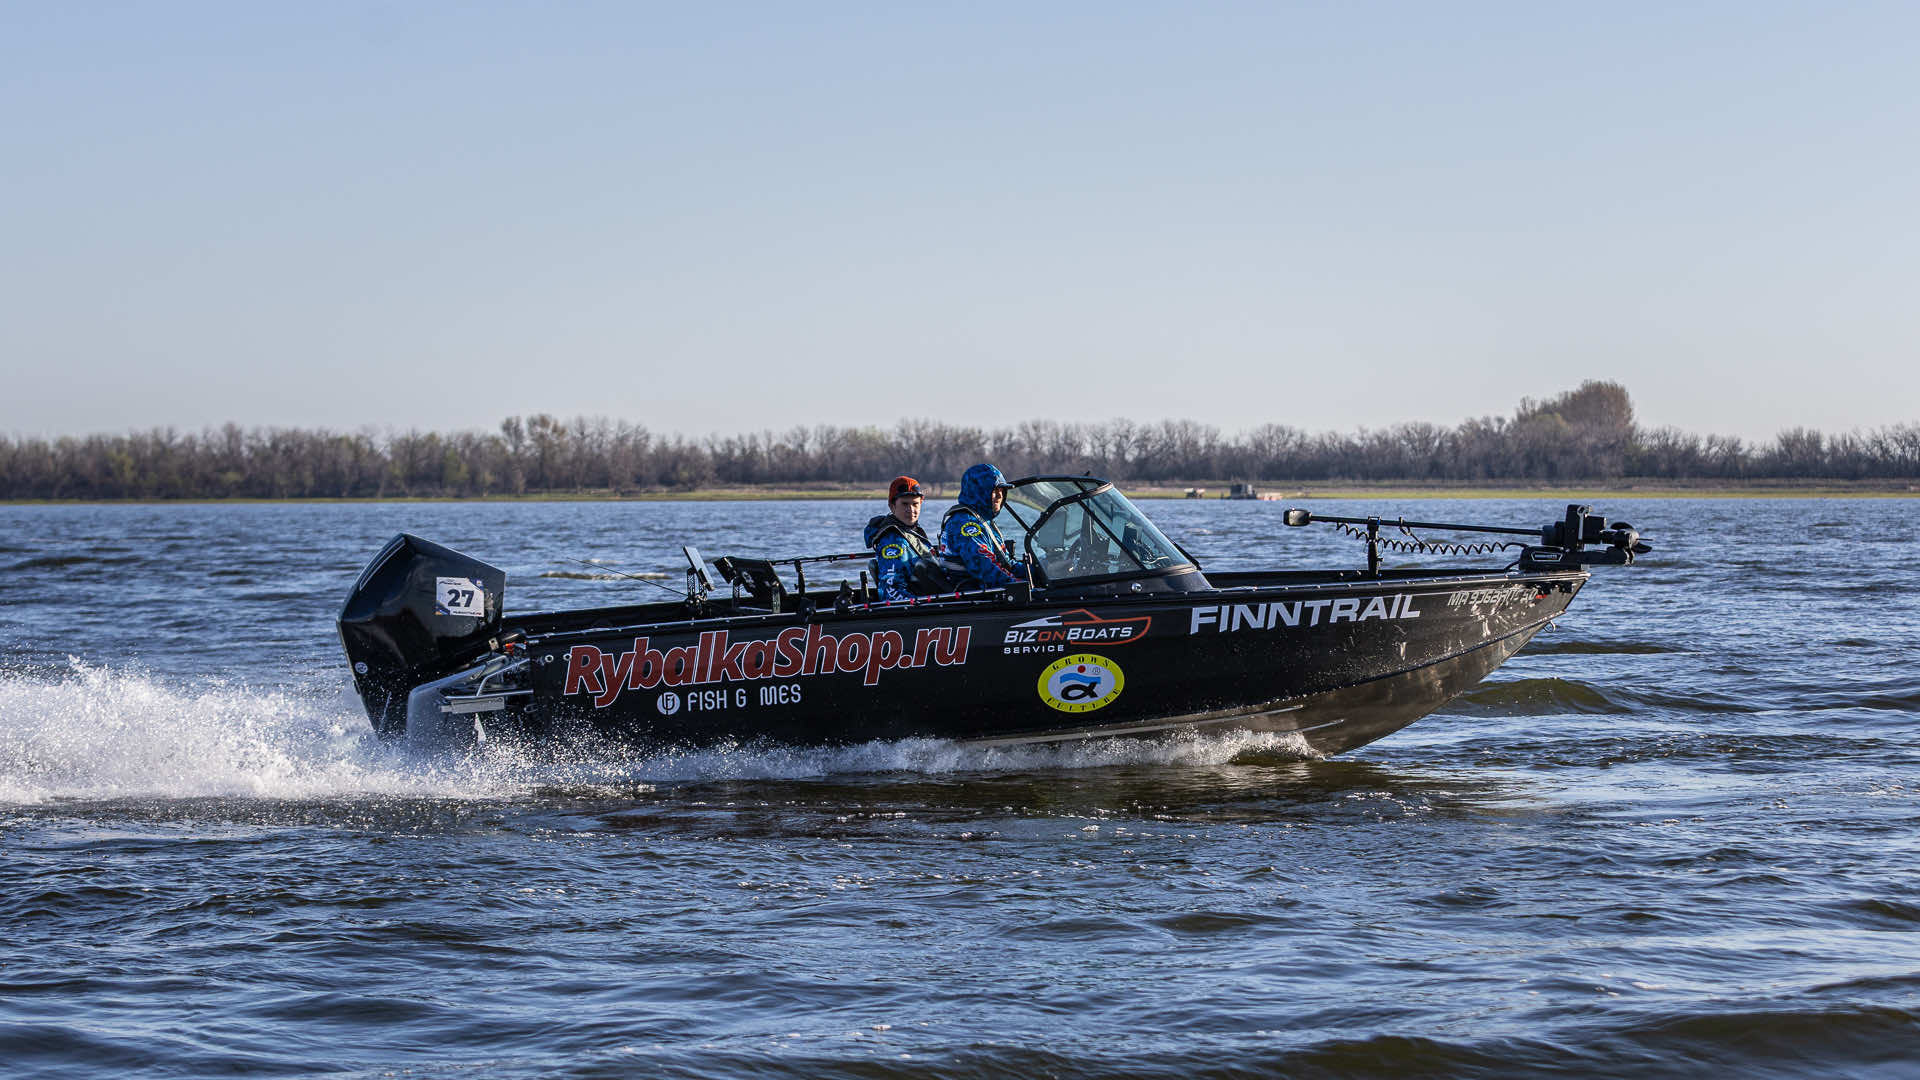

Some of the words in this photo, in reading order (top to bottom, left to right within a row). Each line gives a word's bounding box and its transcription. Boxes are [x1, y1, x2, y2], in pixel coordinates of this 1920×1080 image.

[447, 589, 474, 607] 27
[1190, 594, 1421, 636] FINNTRAIL
[1003, 644, 1065, 655] SERVICE
[563, 624, 972, 709] RybalkaShop.ru
[687, 689, 727, 712] FISH
